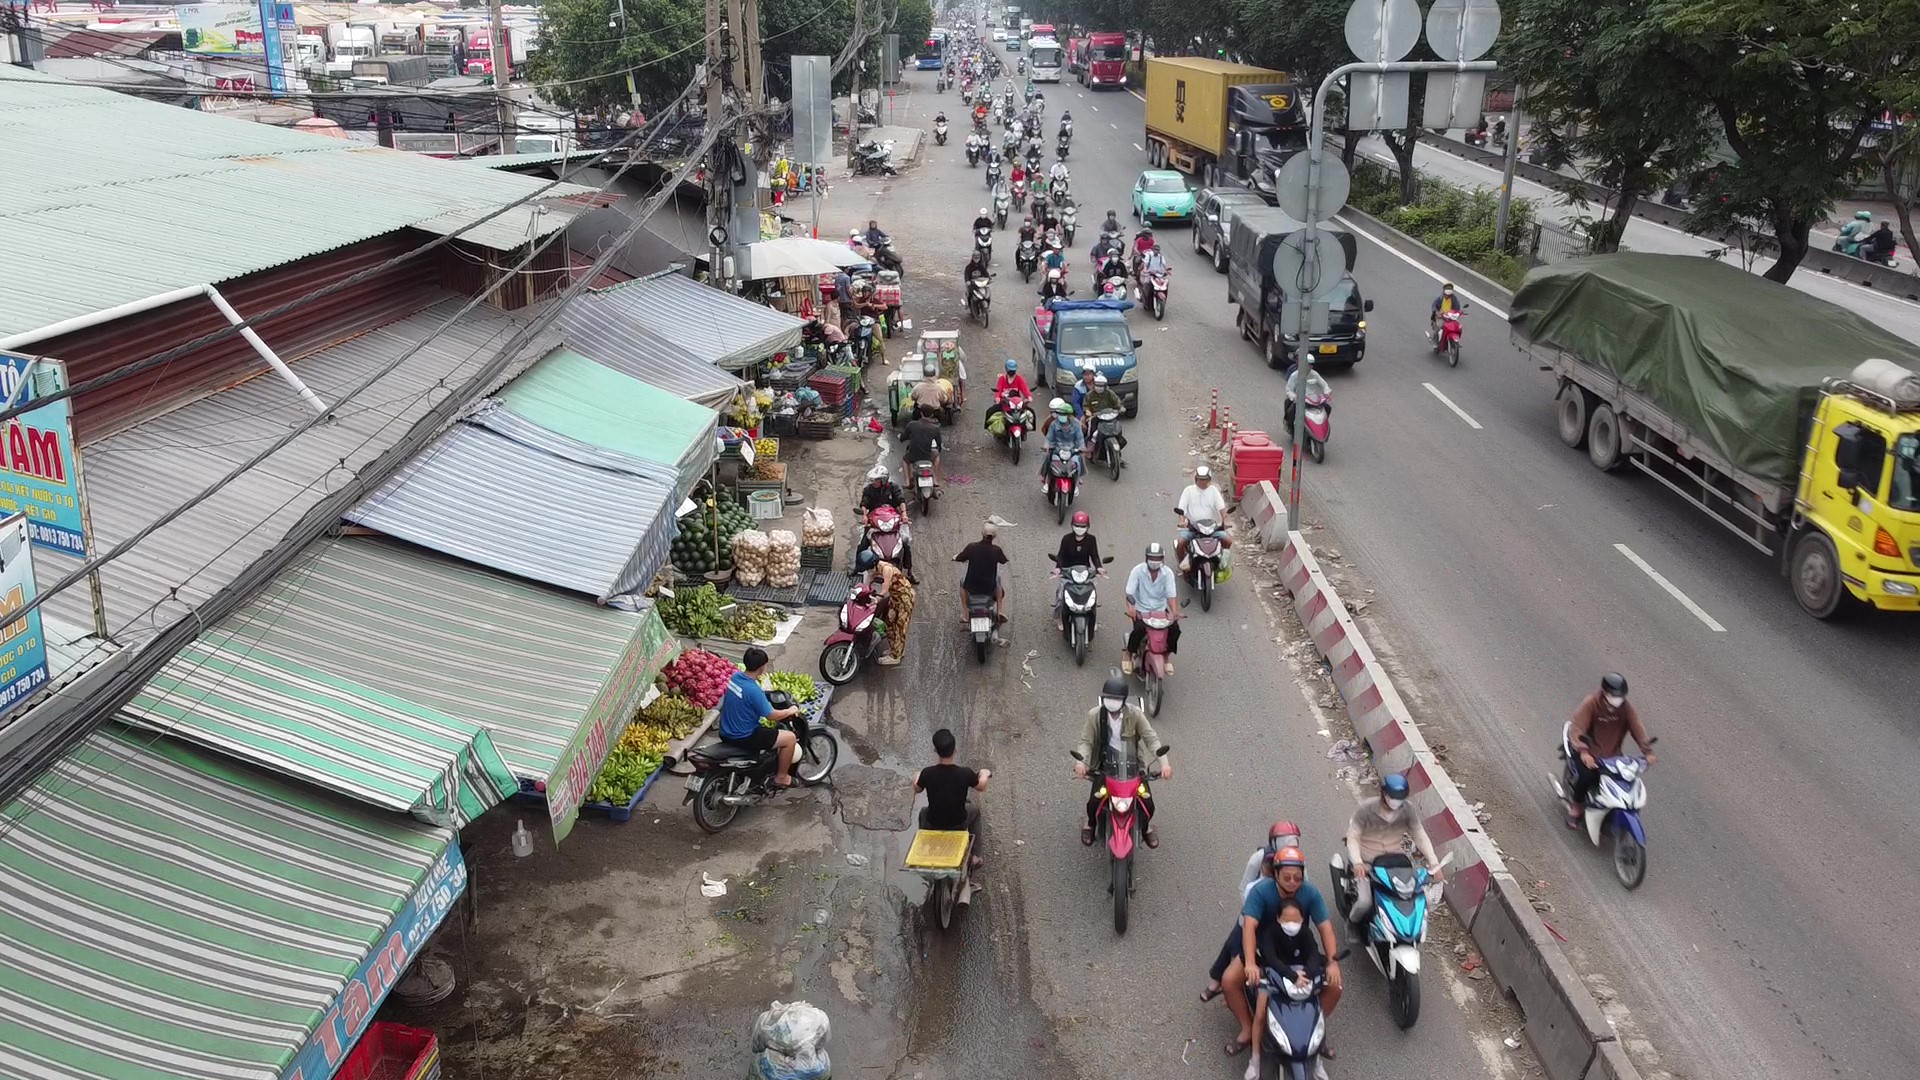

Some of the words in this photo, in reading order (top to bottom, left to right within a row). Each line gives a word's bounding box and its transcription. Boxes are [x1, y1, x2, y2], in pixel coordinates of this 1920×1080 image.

[40, 525, 57, 545] 0913
[57, 530, 71, 548] 750
[70, 533, 84, 551] 734
[15, 675, 31, 695] 750
[30, 667, 46, 686] 734
[430, 884, 451, 916] 750
